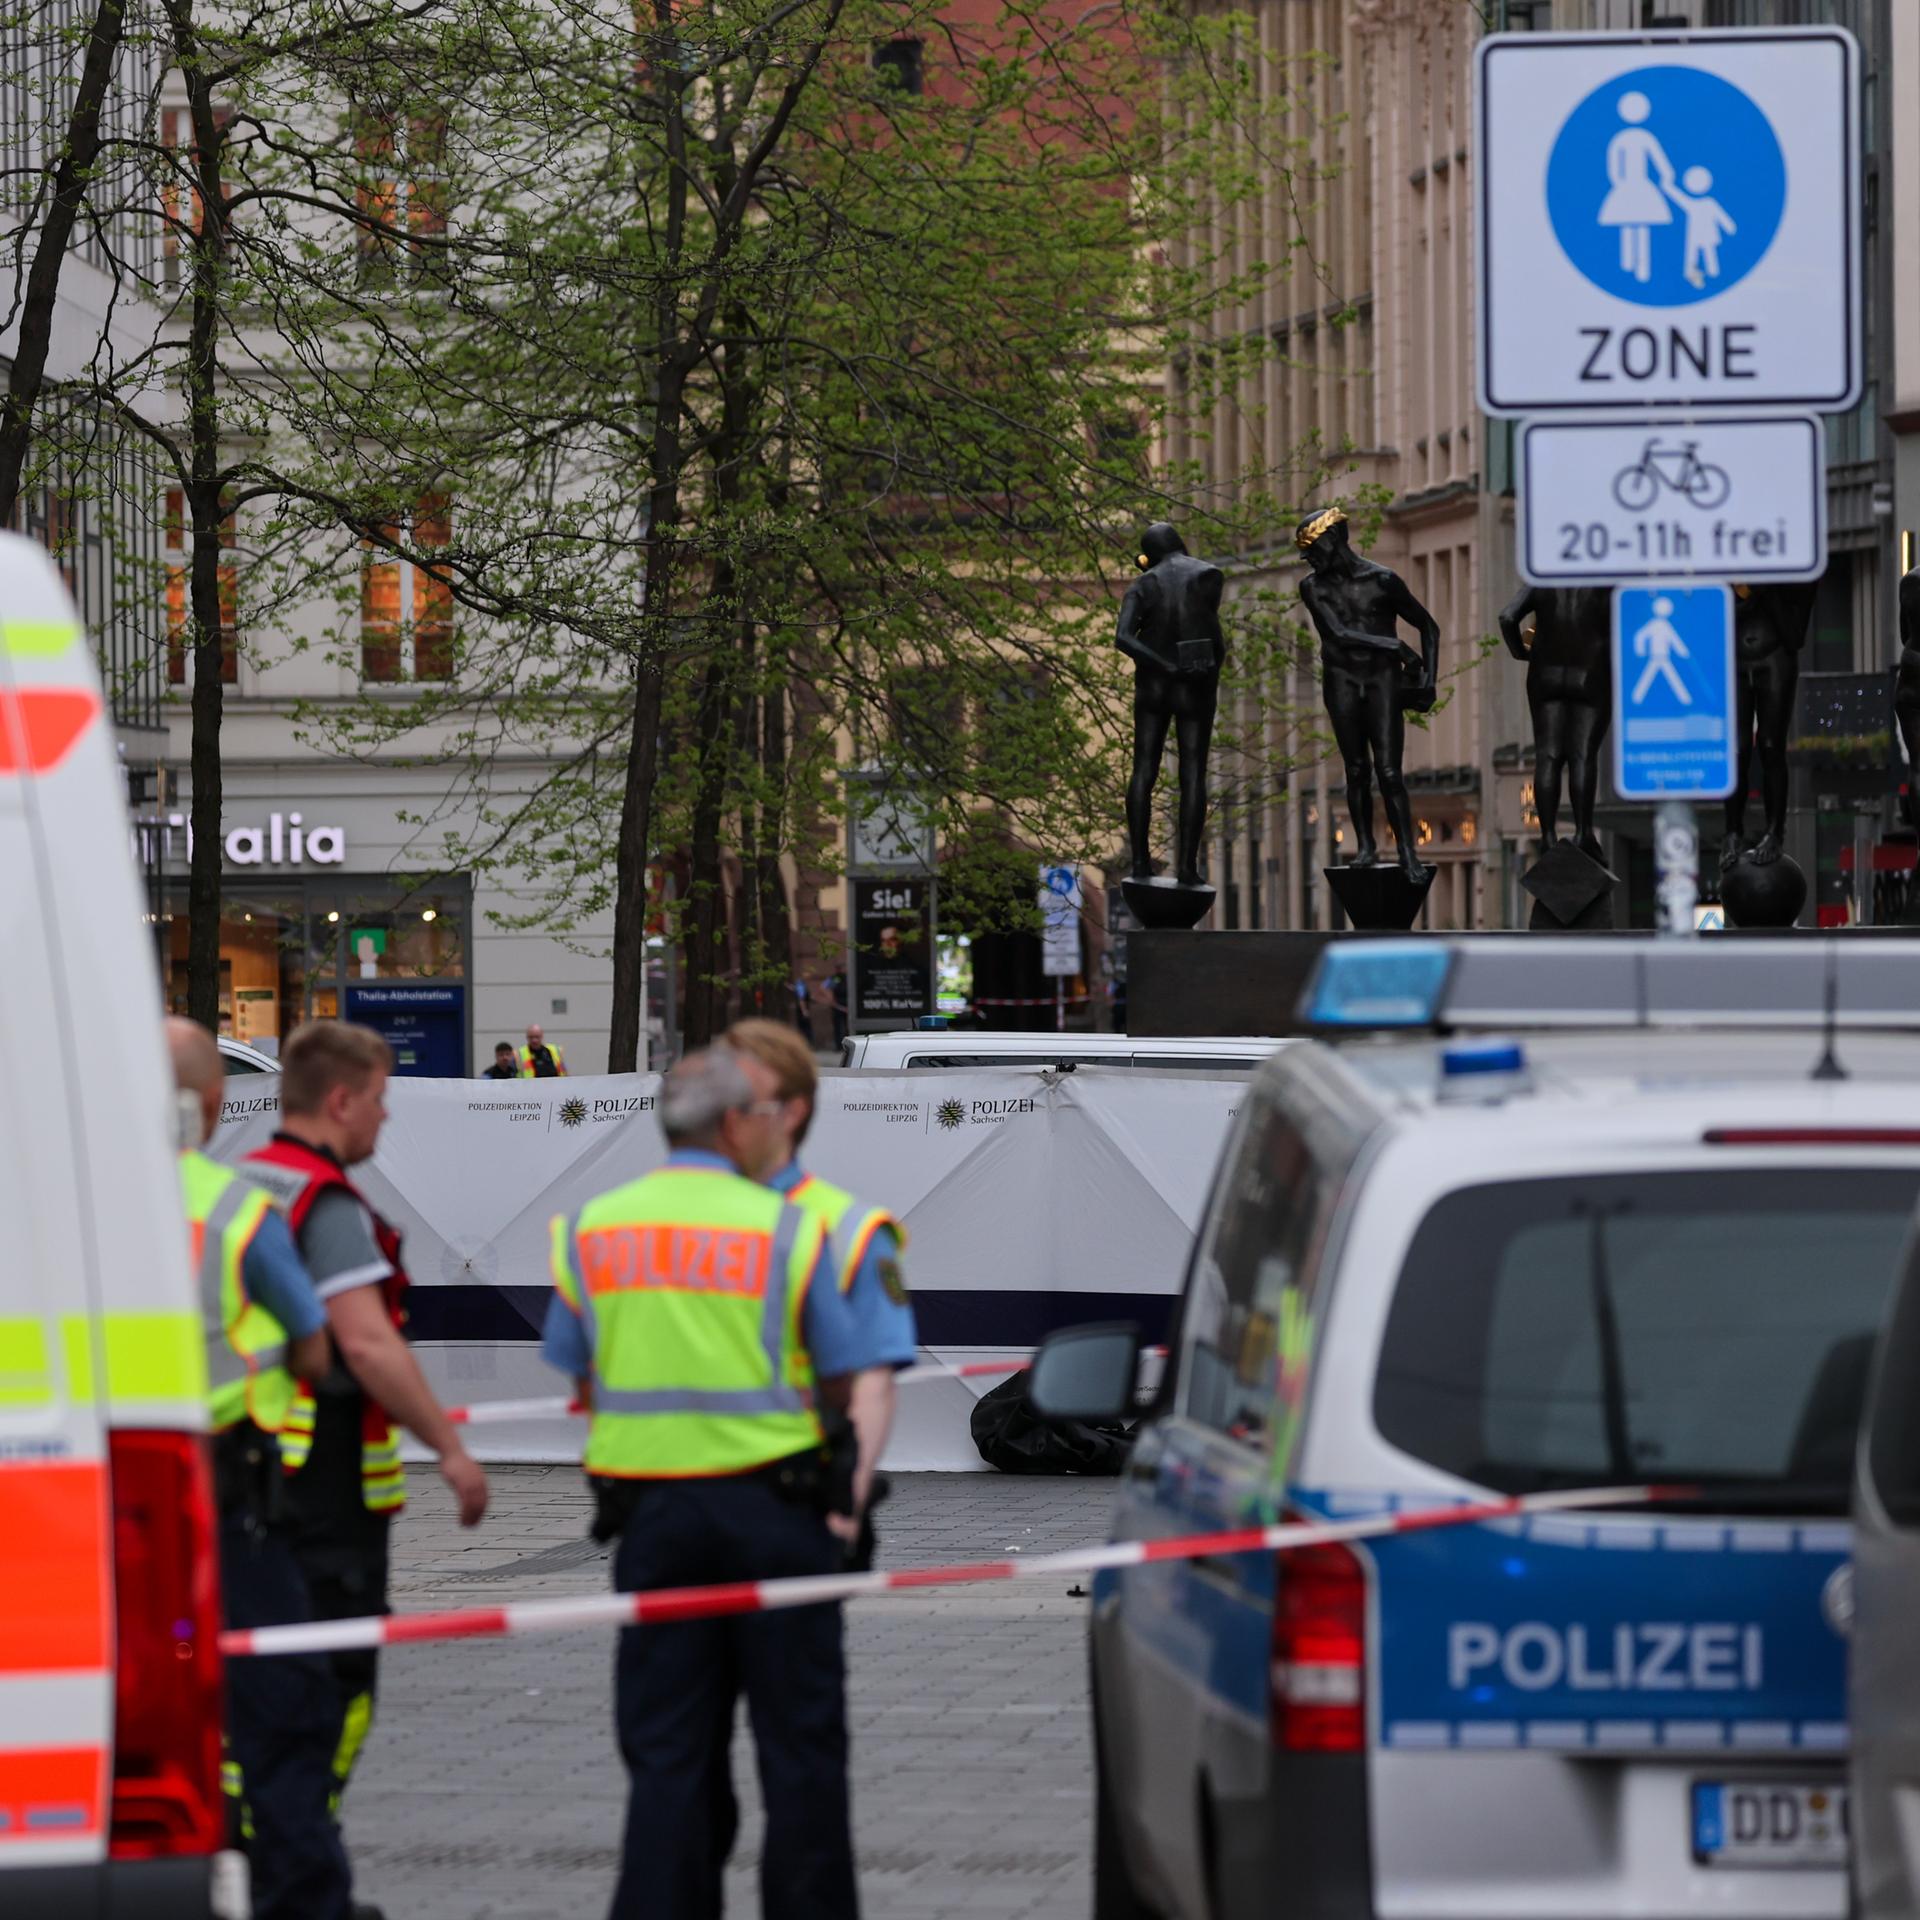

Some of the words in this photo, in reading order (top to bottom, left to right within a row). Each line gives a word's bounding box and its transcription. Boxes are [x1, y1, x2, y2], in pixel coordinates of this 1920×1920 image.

[1578, 324, 1756, 381] ZONE
[1560, 520, 1691, 561] 20-11h
[1712, 518, 1787, 556] frei
[872, 889, 911, 909] Sie!
[356, 990, 453, 1001] Thalia-Abholstation
[222, 1098, 278, 1114] POLIZEI
[468, 1103, 542, 1111] POLIZEIDIREKTION
[594, 1097, 655, 1113] POLIZEI
[843, 1103, 919, 1112] POLIZEIDIREKTION
[972, 1099, 1034, 1114] POLIZEI
[219, 1115, 250, 1125] Sachsen
[509, 1113, 541, 1122] LEIPZIG
[592, 1113, 625, 1123] Sachsen
[886, 1114, 918, 1123] LEIPZIG
[971, 1115, 1005, 1124] Sachsen
[587, 1230, 761, 1291] POLIZEI
[1448, 1621, 1762, 1690] POLIZEI
[1733, 1793, 1800, 1842] DD
